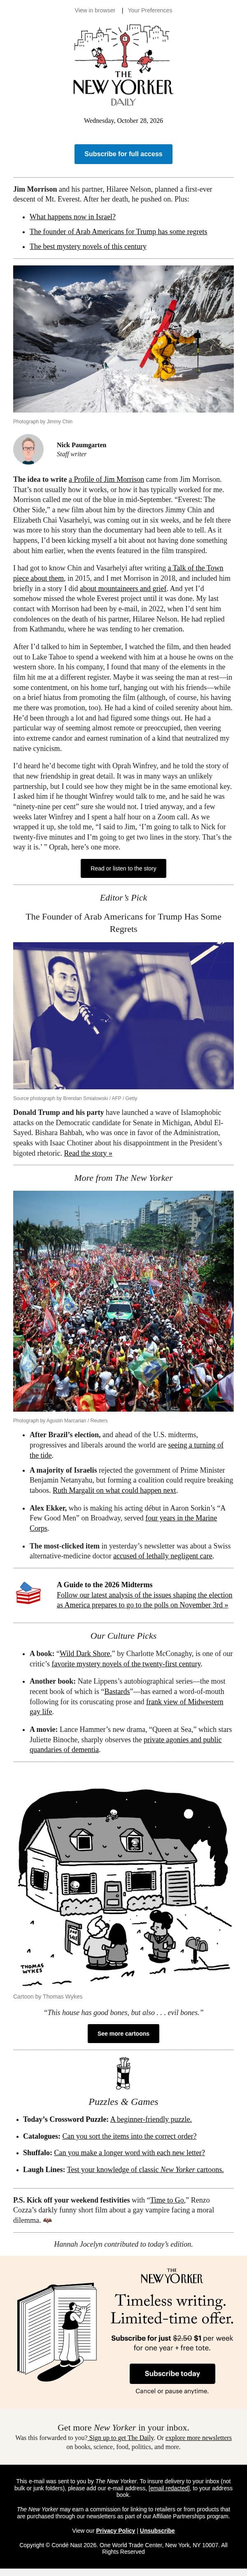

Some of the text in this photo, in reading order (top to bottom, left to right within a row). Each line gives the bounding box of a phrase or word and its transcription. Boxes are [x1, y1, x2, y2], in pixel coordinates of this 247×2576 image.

[73, 79, 174, 95] NEW YORKER
[96, 1175, 112, 1183] from
[141, 2273, 204, 2284] NEW YORKER
[115, 2294, 226, 2310] Timeless writing.
[111, 2312, 233, 2324] Limited-time offer.
